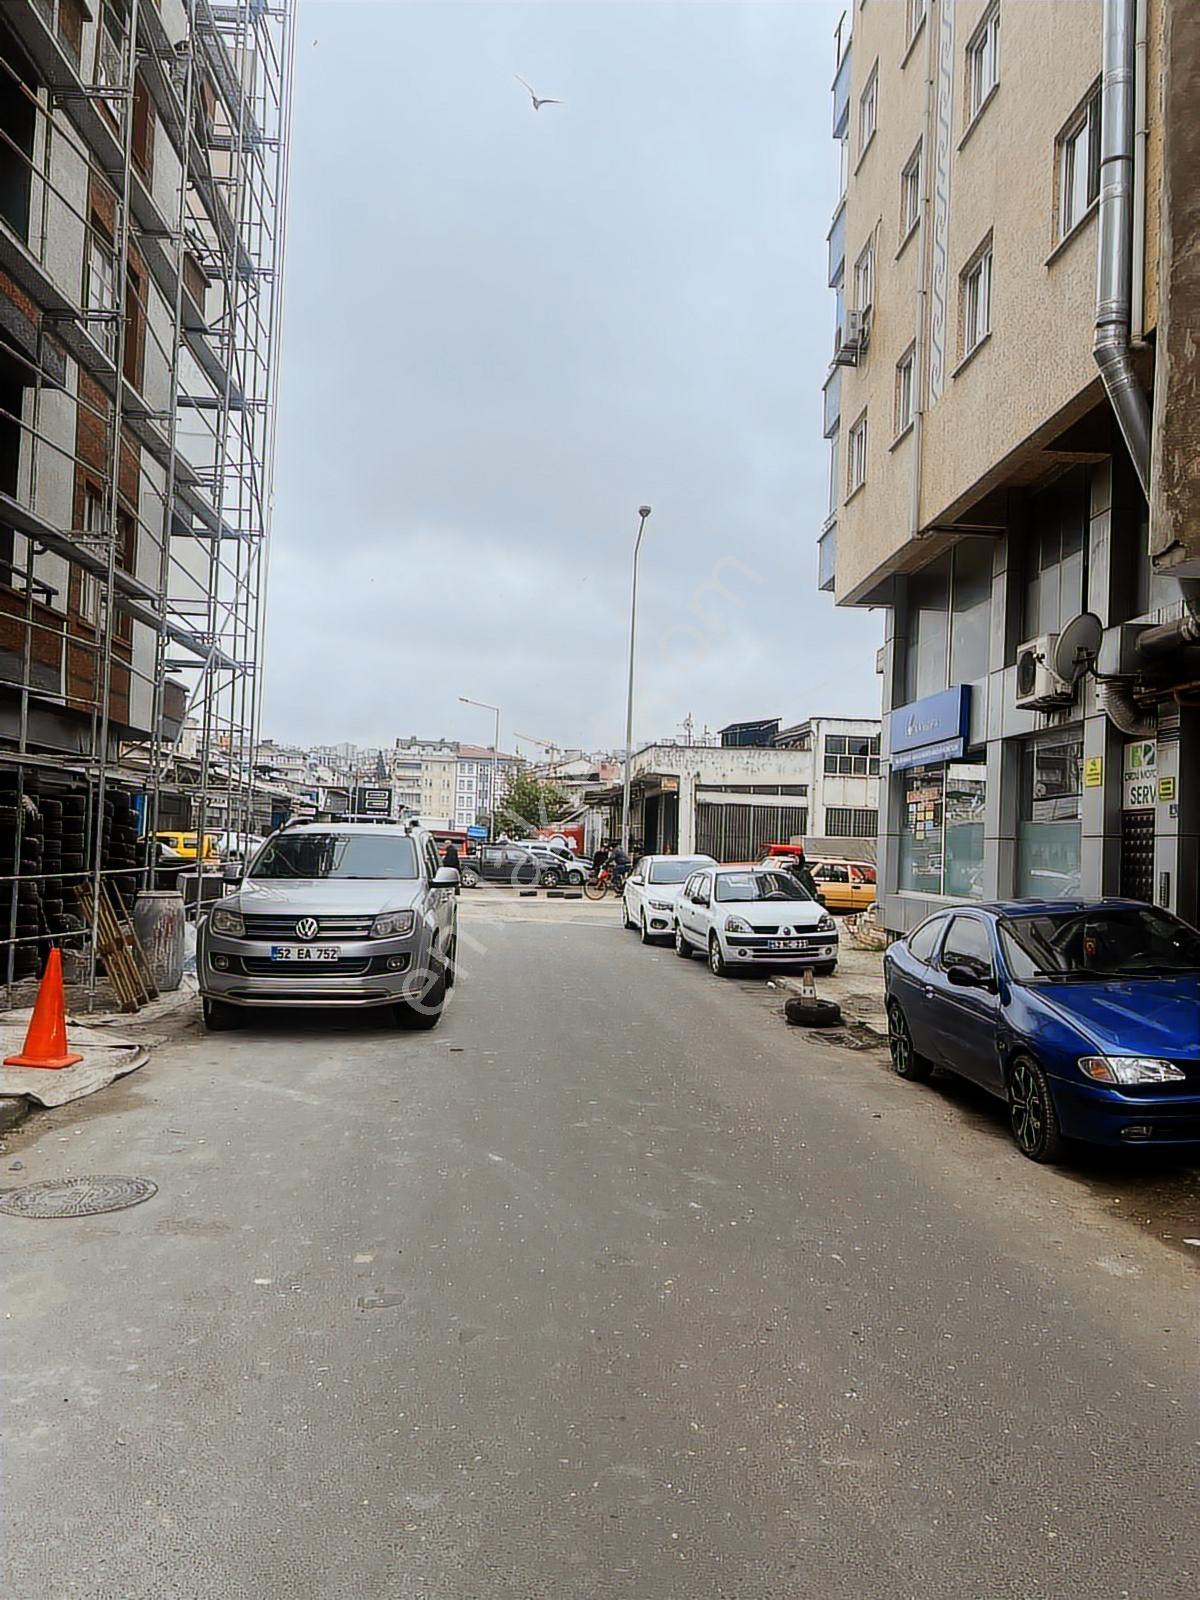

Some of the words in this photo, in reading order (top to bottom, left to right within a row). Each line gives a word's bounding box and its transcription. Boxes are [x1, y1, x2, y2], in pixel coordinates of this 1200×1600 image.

[277, 949, 291, 960] 52
[297, 949, 311, 960] EA
[316, 949, 337, 960] 752
